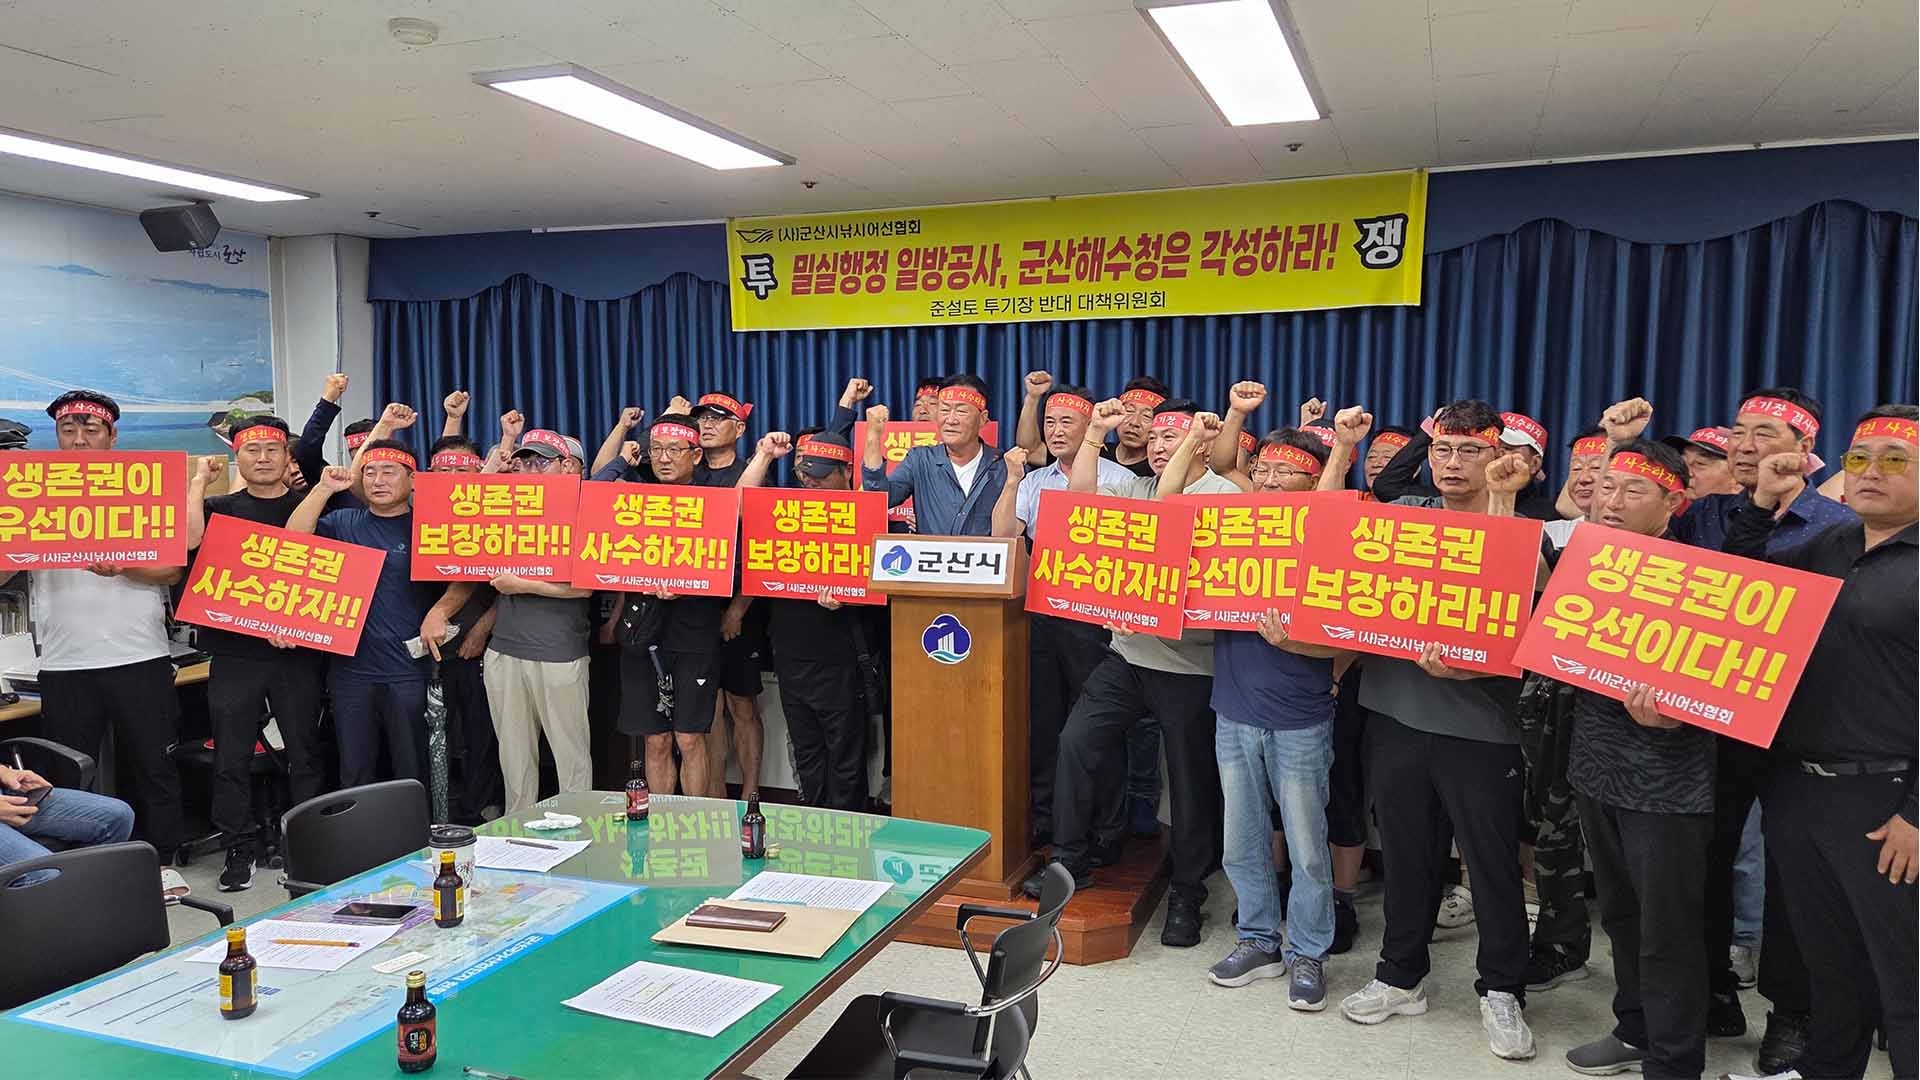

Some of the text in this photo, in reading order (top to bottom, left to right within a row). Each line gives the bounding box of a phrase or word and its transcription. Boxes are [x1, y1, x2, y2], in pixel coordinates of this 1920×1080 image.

[778, 219, 921, 242] (사)군산시낚시어선협회
[1358, 215, 1406, 267] 쟁
[741, 253, 778, 299] 투
[790, 223, 1340, 296] 밀실행정 일방공사, 군산해수청은 각성하라!
[930, 290, 1166, 317] 준설토 투기장 반대 대책위원회
[3, 462, 163, 497] 생존권이
[449, 484, 545, 517] 생존권
[0, 505, 175, 543] 우선이다!!
[613, 493, 704, 529] 생존권
[772, 499, 857, 535] 생존권
[1068, 505, 1159, 553] 생존권
[240, 532, 345, 584] 생존권
[418, 524, 571, 557] 보장하라!!
[580, 532, 728, 570] 사수하자!!
[918, 550, 1002, 576] 군산시
[1351, 516, 1486, 575] 생존권
[192, 565, 363, 629] 사수하자!!
[1034, 548, 1182, 606] 사수하자!!
[1587, 544, 1797, 635] 생존권이
[1302, 564, 1521, 639] 보장하라!!
[1543, 594, 1788, 702] 우선이다!!
